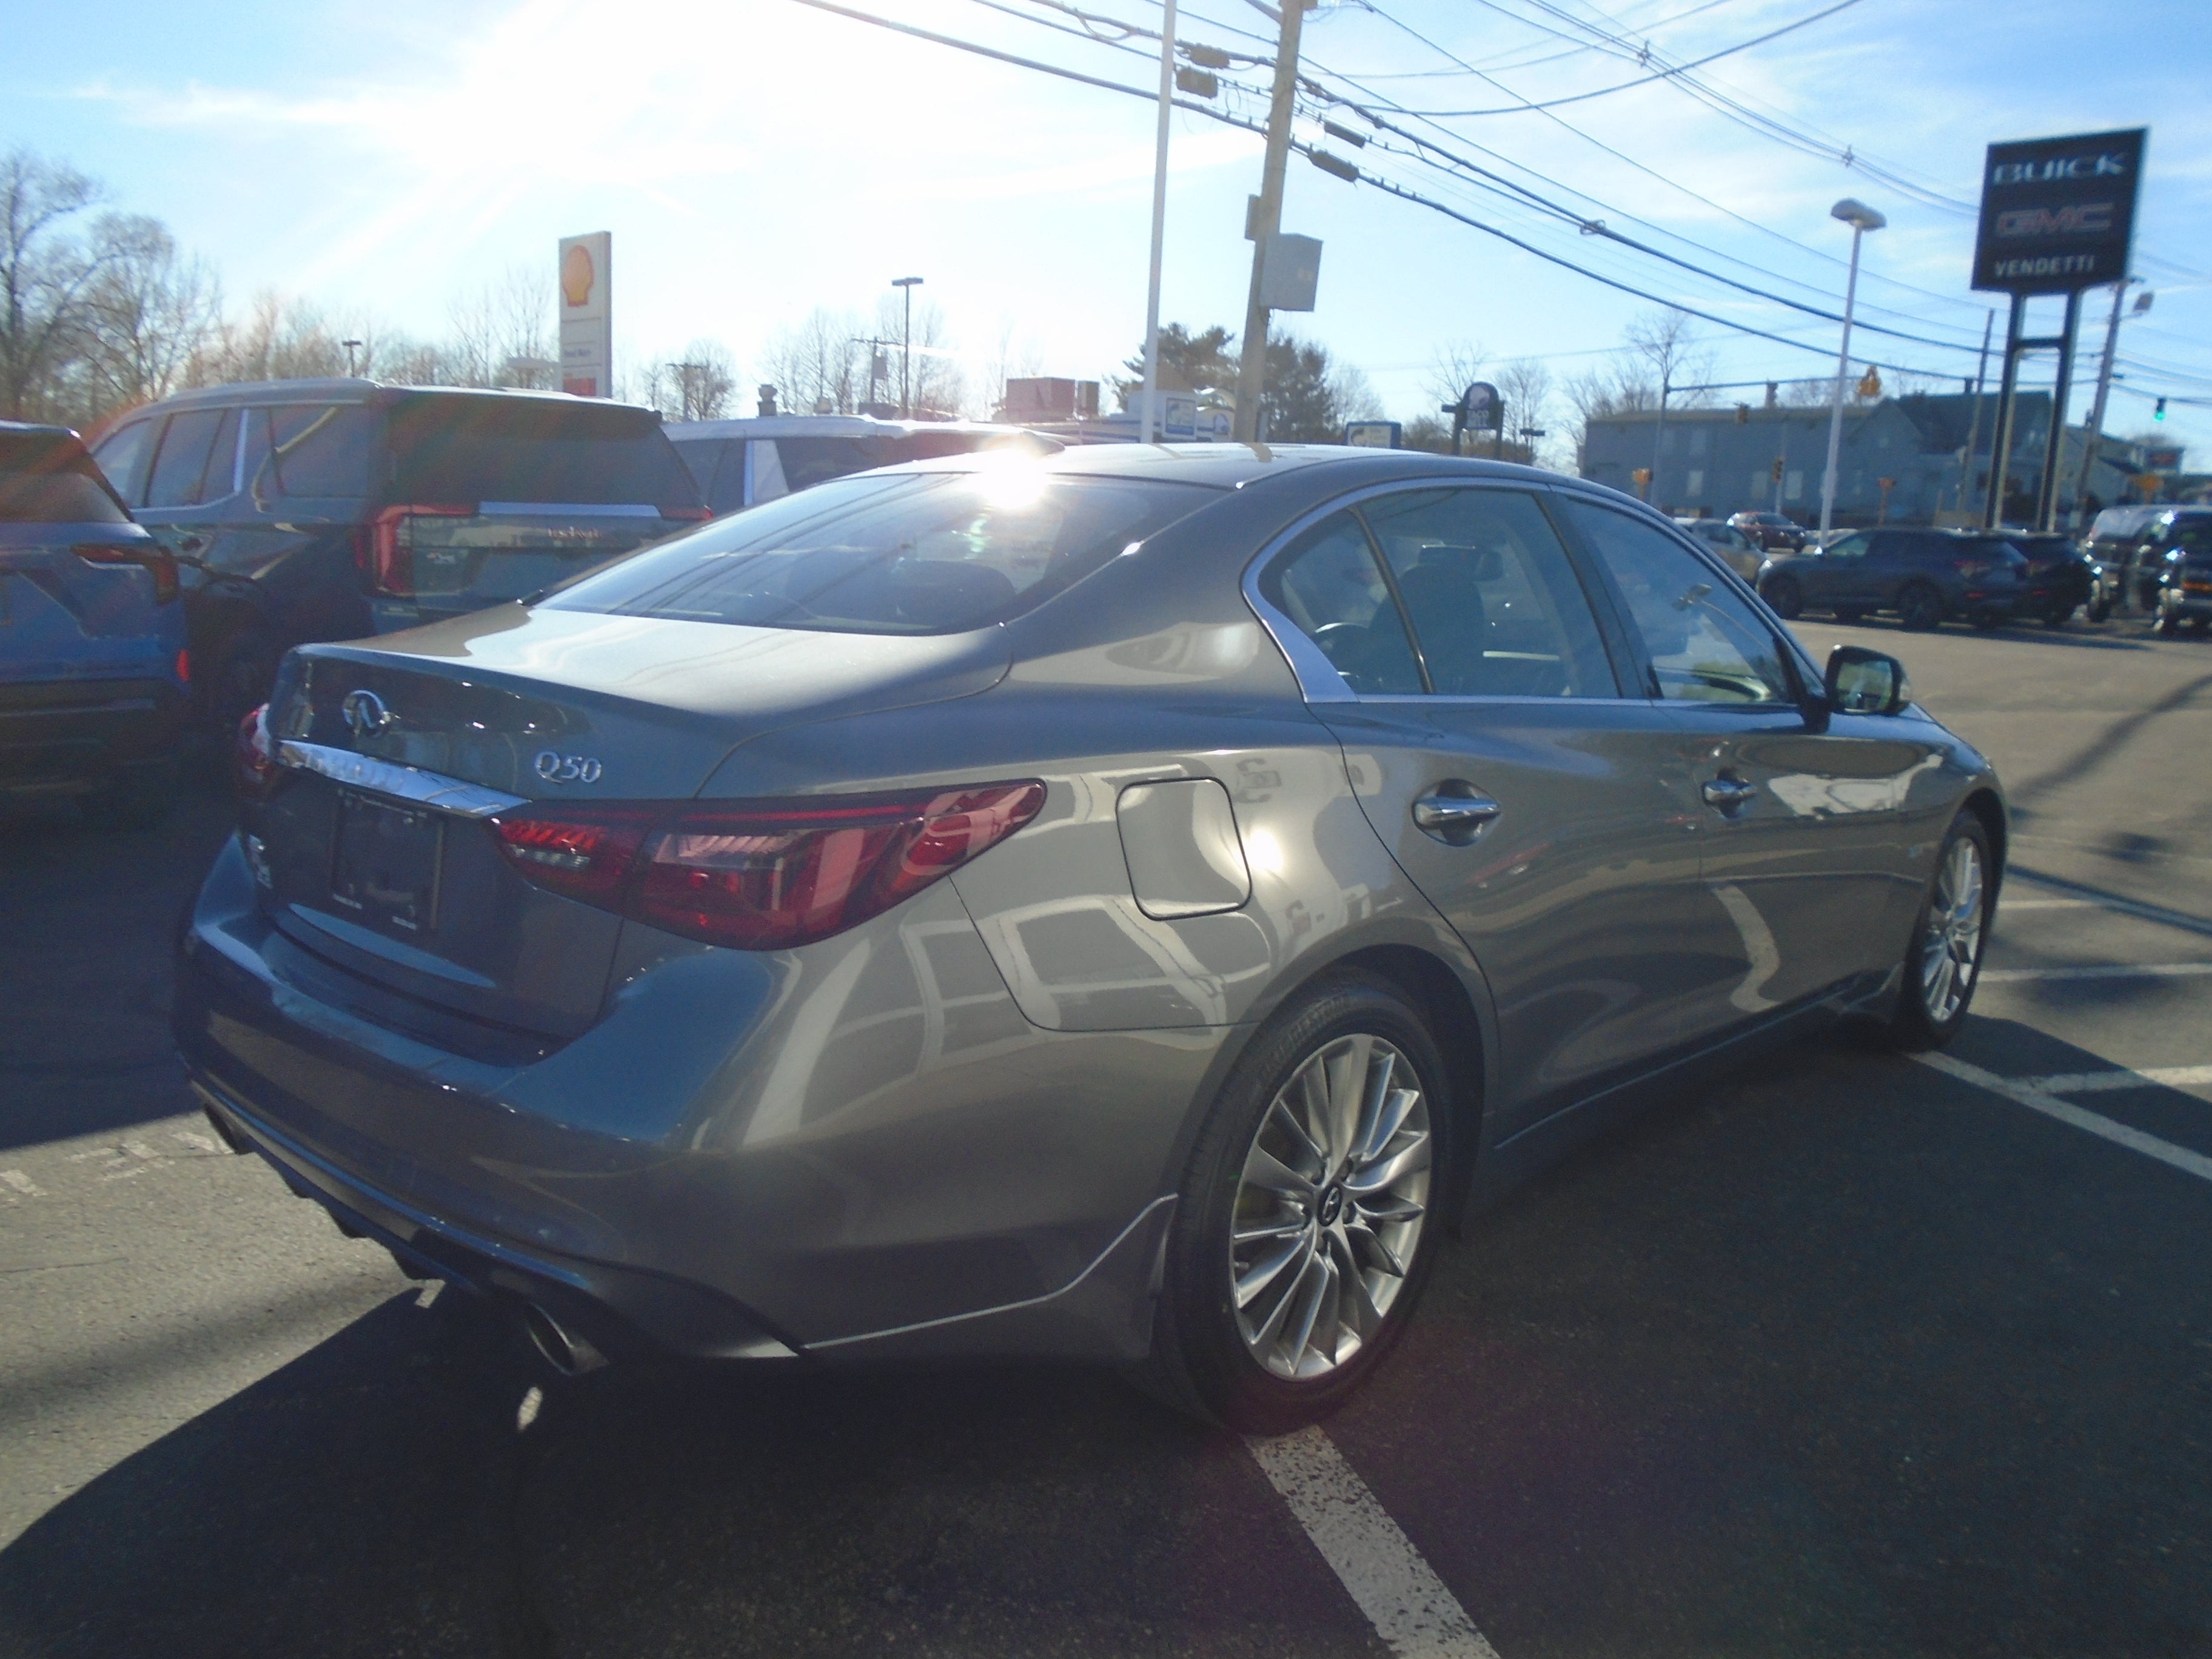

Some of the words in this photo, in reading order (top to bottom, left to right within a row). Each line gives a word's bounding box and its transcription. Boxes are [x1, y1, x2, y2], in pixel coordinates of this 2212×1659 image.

[1993, 153, 2127, 184] BUICK
[1997, 203, 2114, 236] GMC
[1995, 255, 2094, 277] VENDETTI
[534, 751, 602, 783] Q50
